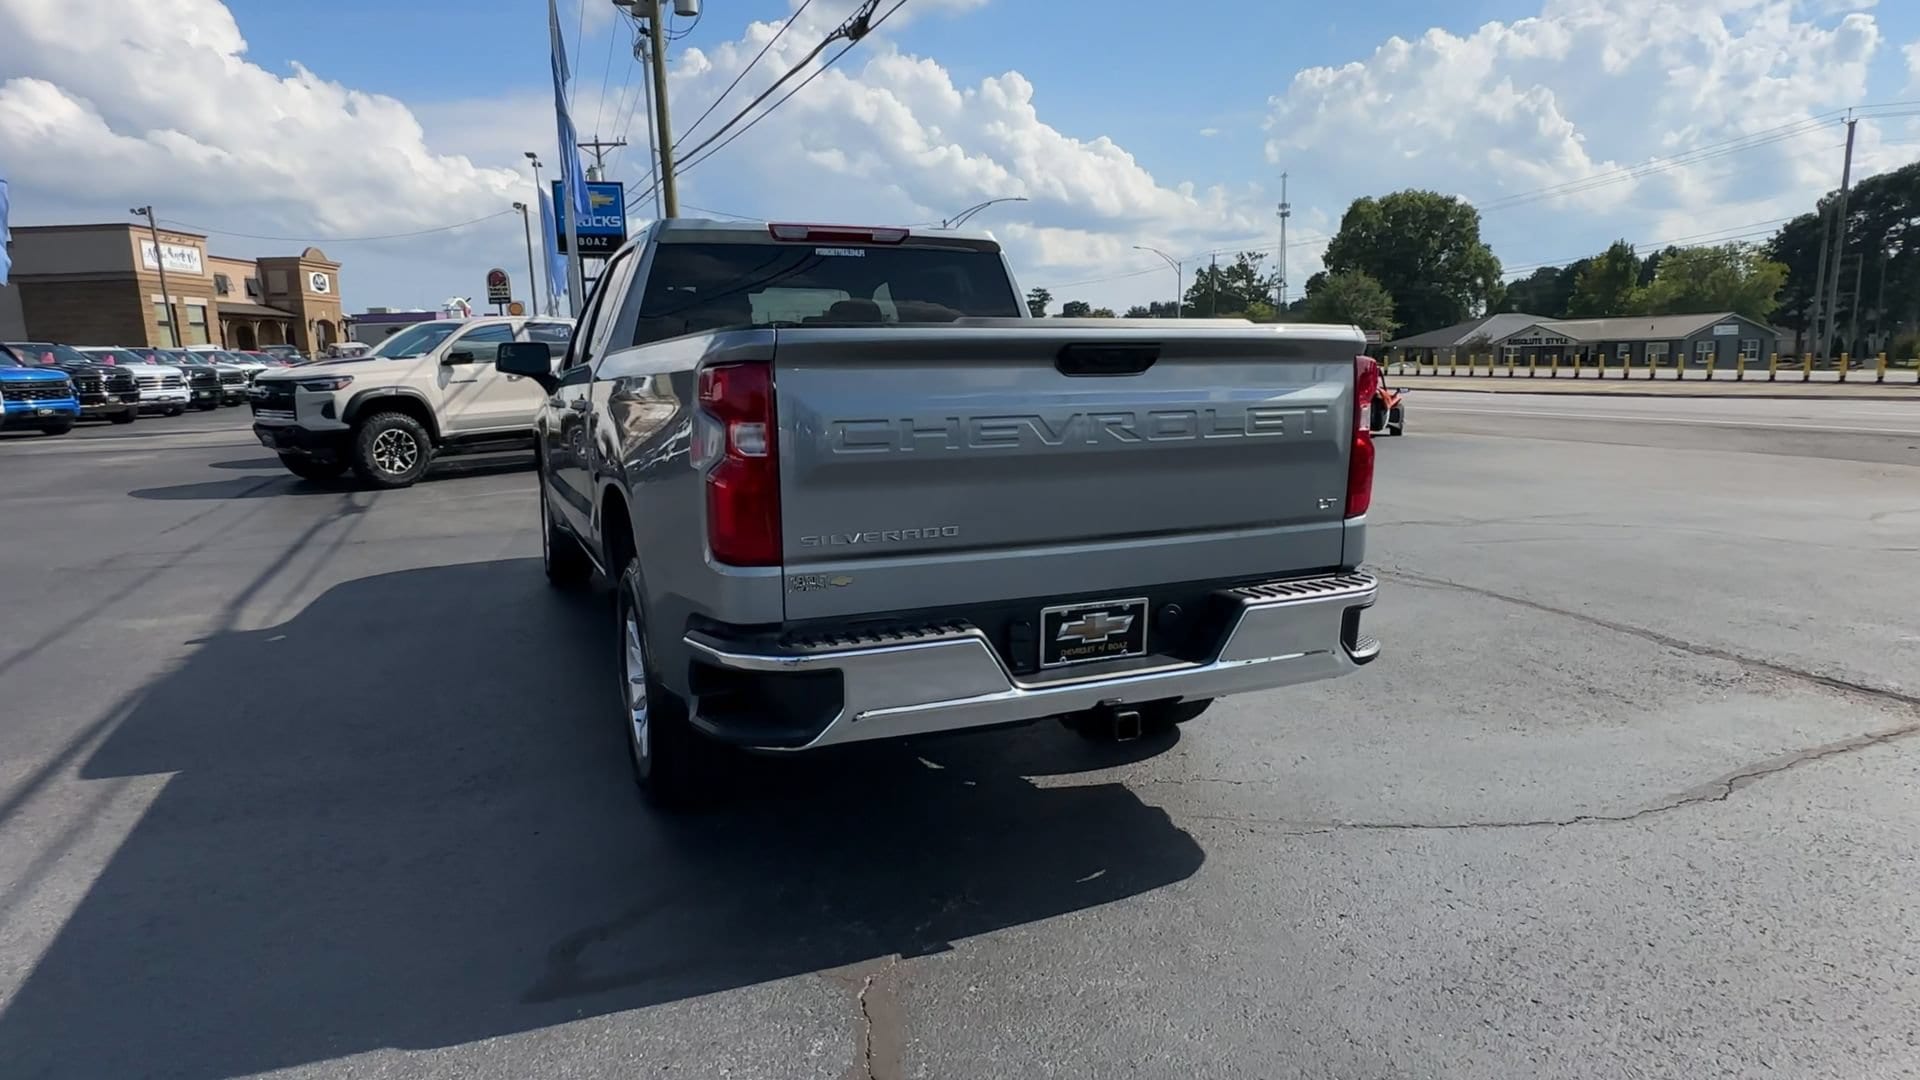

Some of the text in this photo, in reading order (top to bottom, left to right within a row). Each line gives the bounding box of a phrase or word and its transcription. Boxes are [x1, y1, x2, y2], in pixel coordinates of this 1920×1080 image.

[561, 215, 621, 227] UCKS
[578, 236, 608, 246] BOAZ
[831, 405, 1329, 454] CHEVROLET
[1318, 497, 1337, 509] LT
[800, 525, 960, 547] SILVERADO
[1108, 641, 1127, 650] BOAZ
